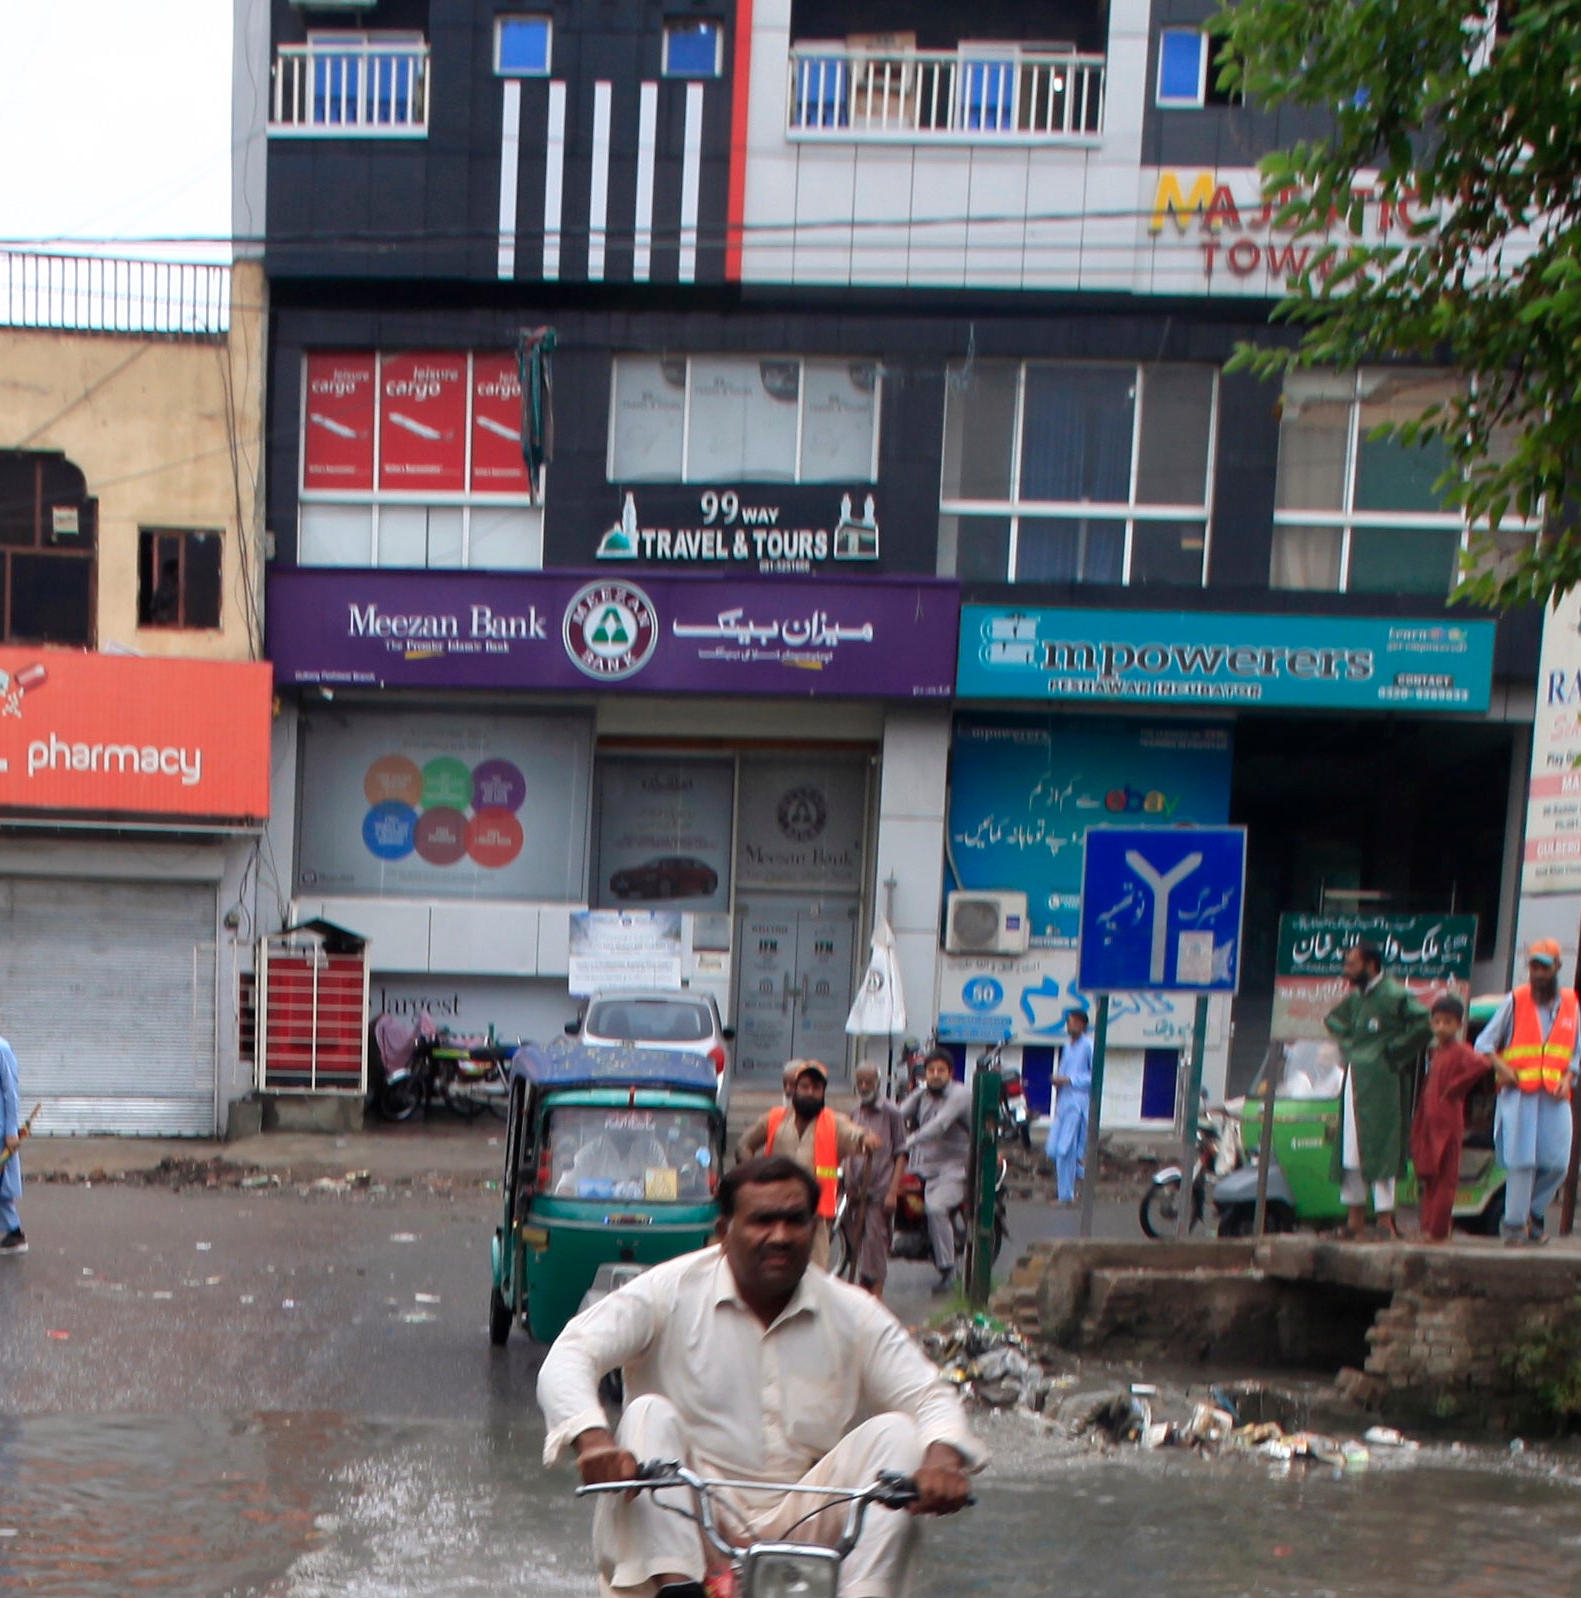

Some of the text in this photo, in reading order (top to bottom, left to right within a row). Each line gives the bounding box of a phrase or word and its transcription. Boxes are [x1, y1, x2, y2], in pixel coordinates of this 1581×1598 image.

[311, 379, 355, 398] cargo
[412, 365, 459, 383] leisure
[385, 379, 441, 402] cargo
[700, 490, 779, 525] 99 WAY
[641, 529, 828, 560] TRAVEL & TOURS
[348, 603, 547, 639] Meezan Bank
[572, 587, 650, 628] MEEZAN
[673, 607, 873, 647] میزان بینک
[385, 638, 403, 651] The
[447, 639, 482, 652] Islamic
[485, 641, 509, 653] Bank
[581, 649, 637, 674] BANK
[1396, 673, 1450, 688] CONTACT
[28, 731, 202, 786] pharmacy
[1104, 783, 1182, 820] ebay
